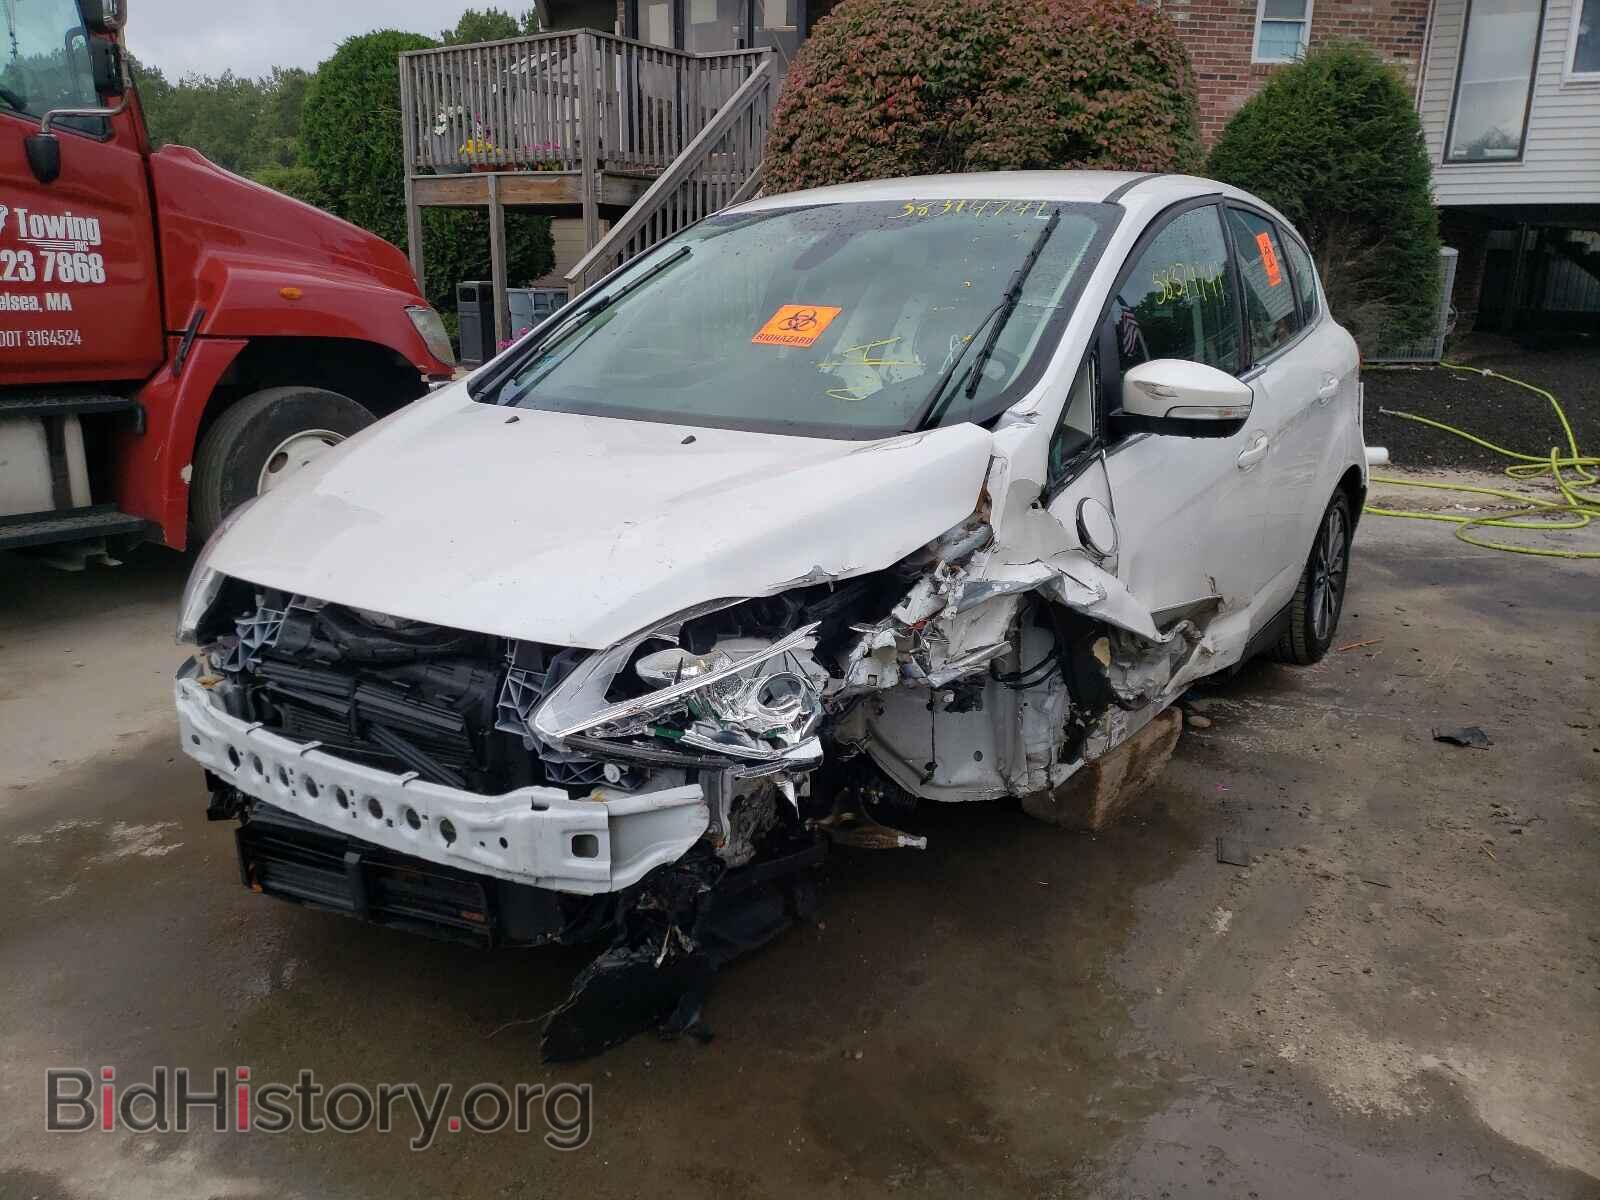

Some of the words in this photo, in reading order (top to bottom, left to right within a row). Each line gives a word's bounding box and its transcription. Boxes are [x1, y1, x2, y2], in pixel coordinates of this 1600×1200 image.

[14, 208, 102, 246] Towing
[0, 250, 36, 282] 23
[40, 251, 106, 283] 7868
[45, 292, 72, 311] MA
[27, 330, 82, 347] 3164524
[756, 333, 816, 345] BIOHAZARD
